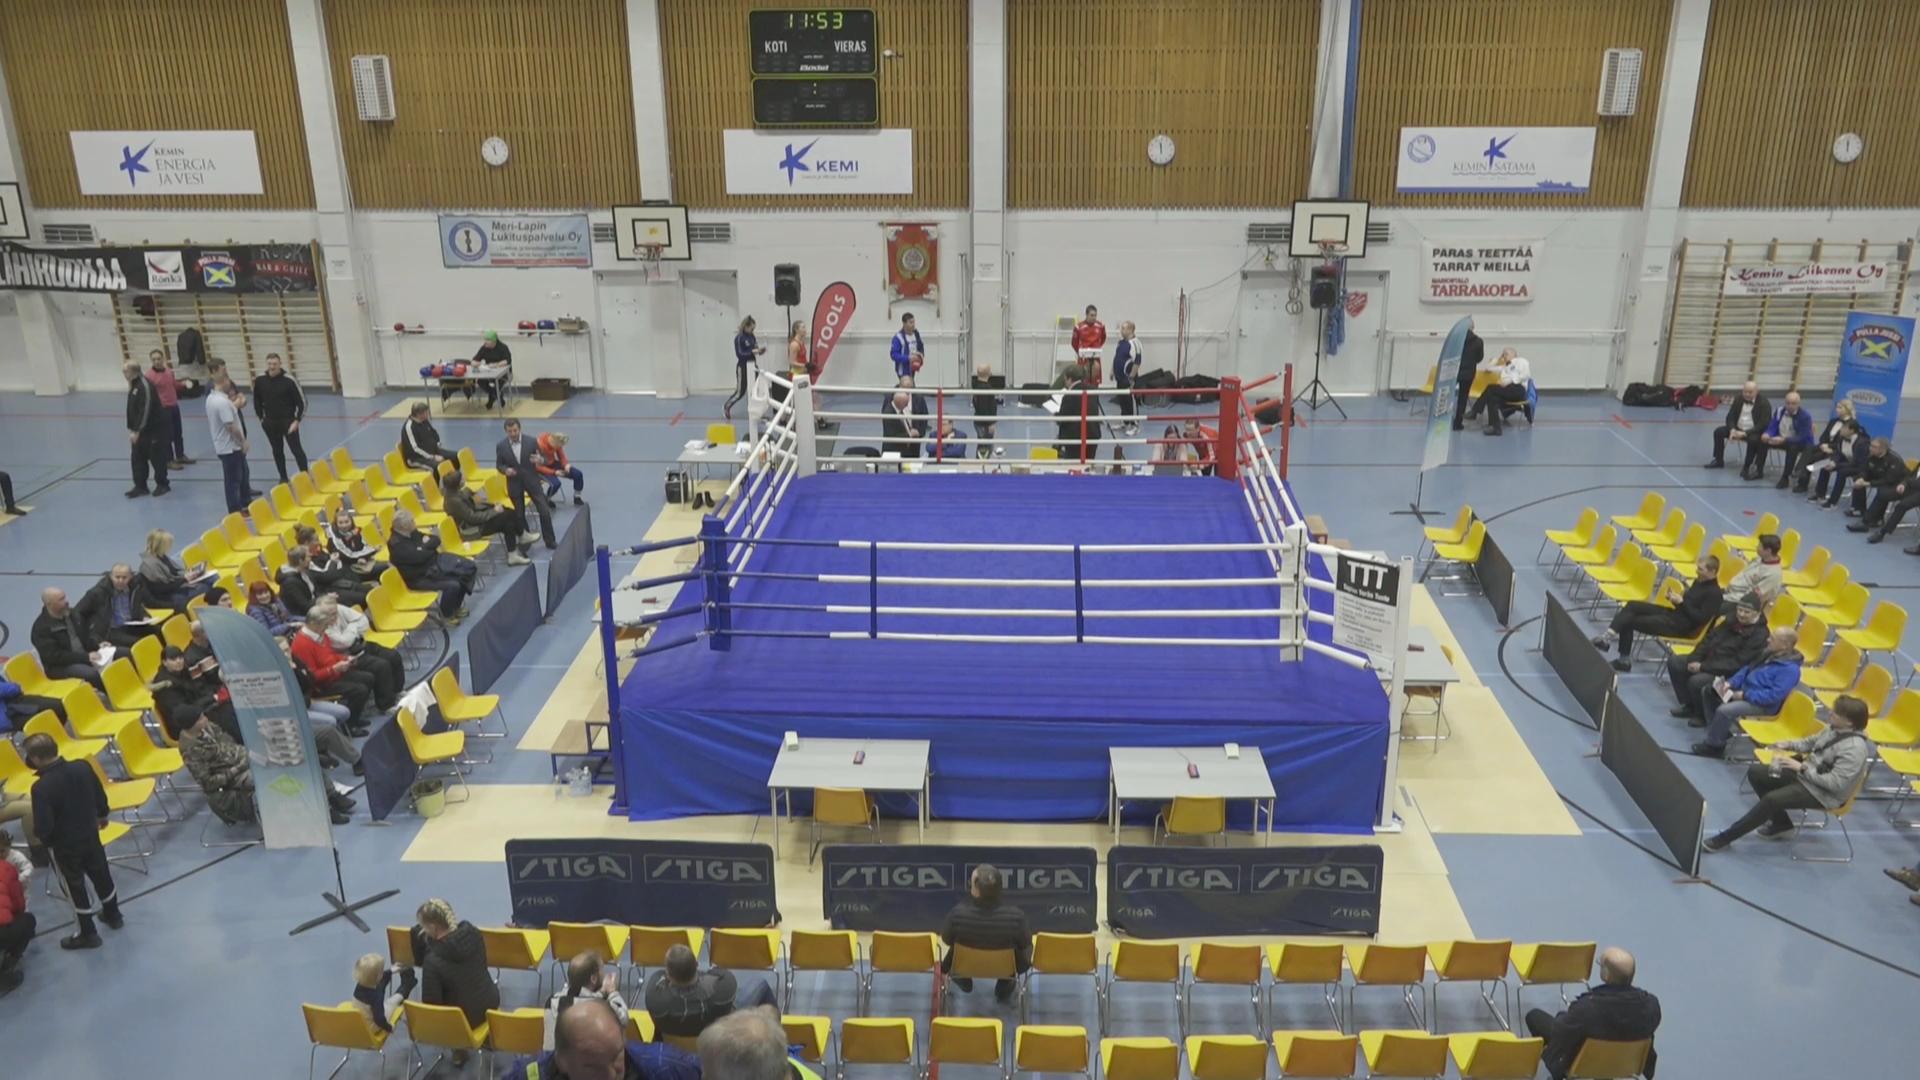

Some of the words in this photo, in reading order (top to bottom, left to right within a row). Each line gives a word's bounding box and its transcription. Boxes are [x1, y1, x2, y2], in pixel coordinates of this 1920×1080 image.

[789, 12, 843, 29] 11:53
[765, 41, 787, 53] KOTI
[834, 41, 867, 53] VIERAS
[154, 148, 184, 156] KEMIN
[156, 159, 216, 170] ENERGIA
[816, 160, 859, 172] KEMI
[1453, 161, 1488, 171] KEMIN
[1494, 161, 1536, 171] SATAMA
[159, 173, 172, 185] JA
[174, 173, 204, 184] VESI
[492, 221, 547, 232] Meri-Lapin
[491, 232, 564, 243] Lukituspalvelu
[568, 231, 582, 242] Oy
[1432, 248, 1473, 258] PARAS
[1478, 246, 1533, 258] TEETTÄÄ
[0, 246, 127, 290] ÄHIRUOKAA
[1433, 262, 1480, 272] TARRAT
[1484, 260, 1531, 272] MEILLÄ
[1730, 268, 1783, 281] Kemin
[1787, 264, 1852, 280] Liikenne
[1431, 284, 1528, 297] TARRAKOPLA
[816, 293, 846, 349] TOOLS
[1347, 561, 1389, 590] TTT
[519, 856, 626, 879] STIGA
[652, 858, 762, 881] STIGA
[837, 866, 947, 888] STIGA
[998, 868, 1084, 889] TIGA
[1122, 868, 1232, 889] STIGA
[1258, 866, 1369, 889] STIGA
[729, 900, 768, 909] STIGA
[1049, 905, 1087, 915] STIGA
[1333, 908, 1372, 918] STIGA
